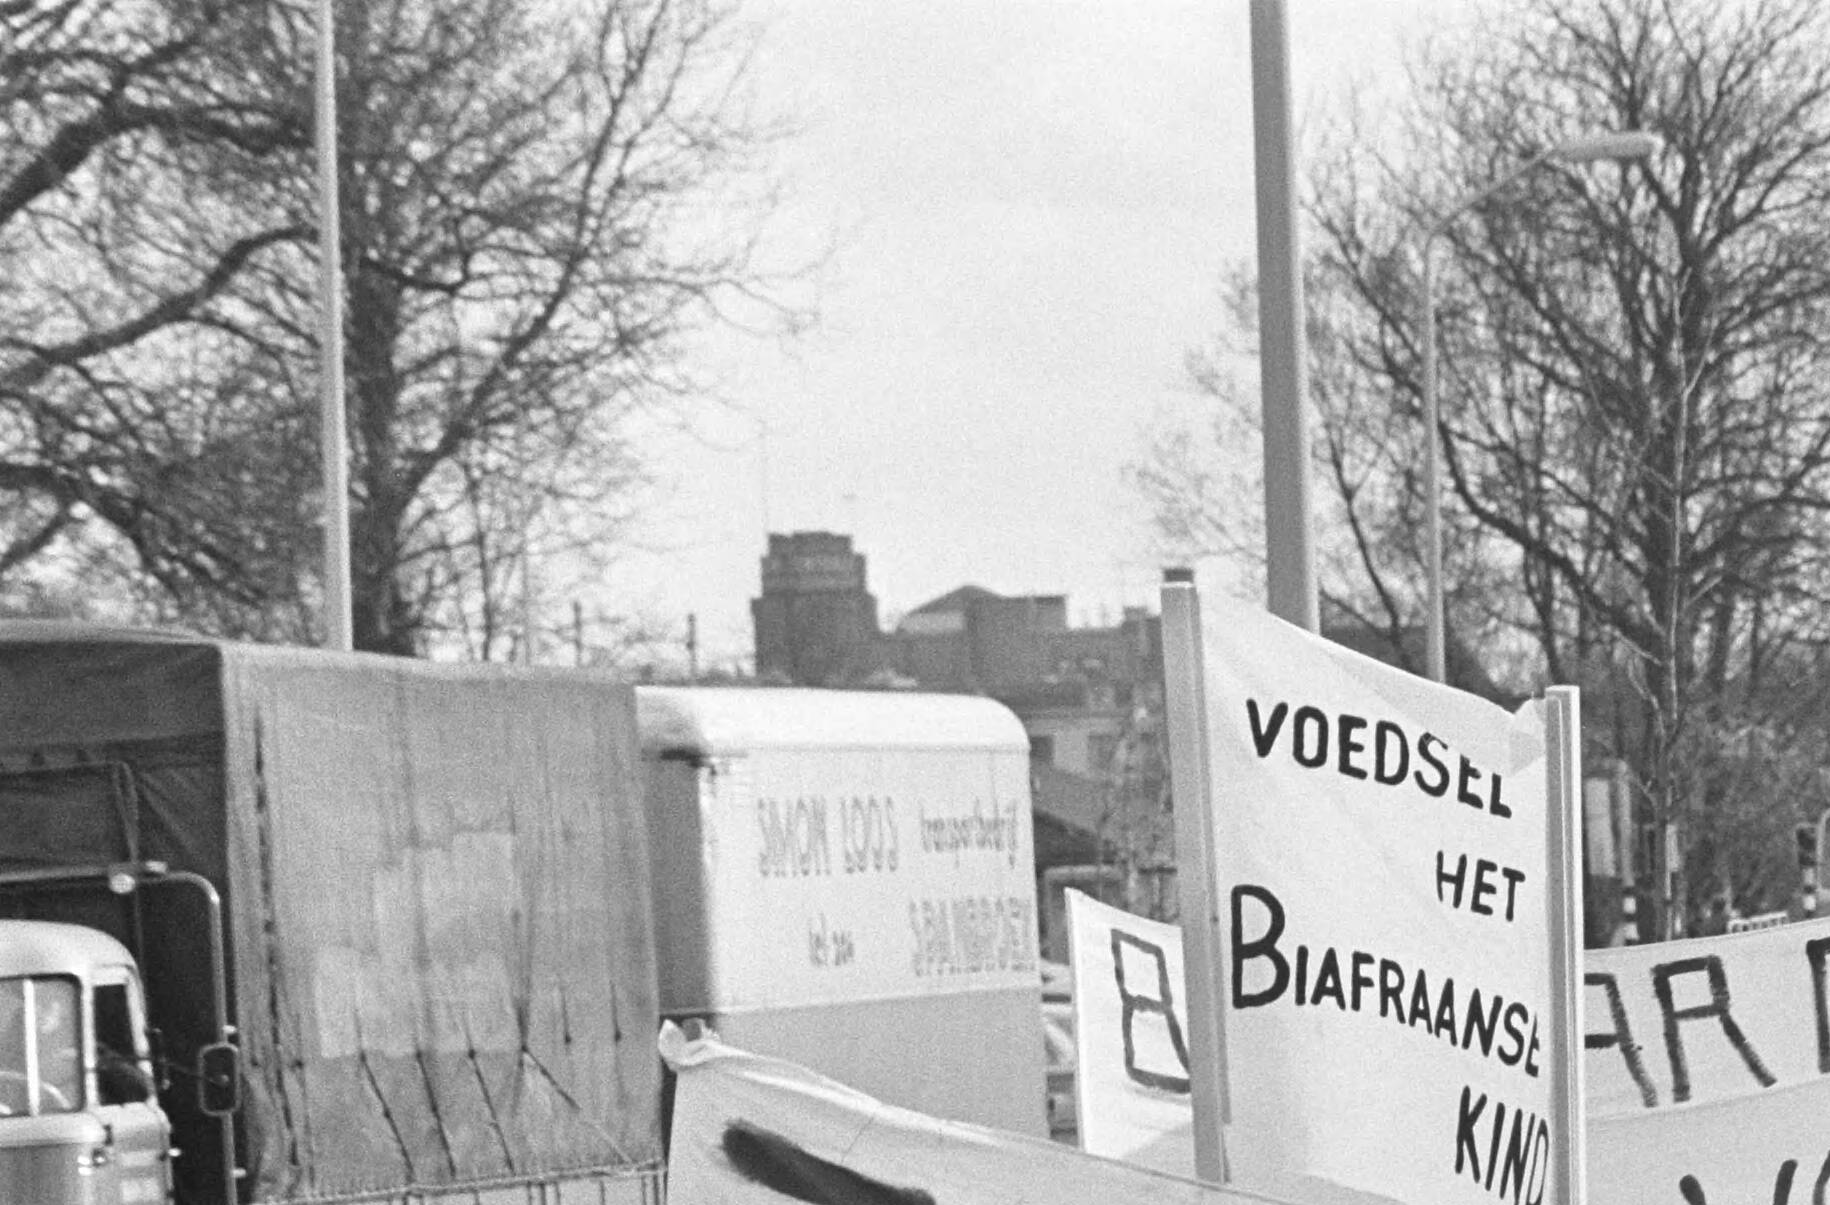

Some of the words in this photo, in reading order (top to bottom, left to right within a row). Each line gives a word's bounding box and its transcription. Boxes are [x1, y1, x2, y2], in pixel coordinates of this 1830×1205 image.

[1245, 697, 1513, 819] VOEDSEL
[839, 794, 900, 875] LOOS
[1435, 850, 1526, 922] HET
[1230, 884, 1540, 1079] BIAFRAANSE
